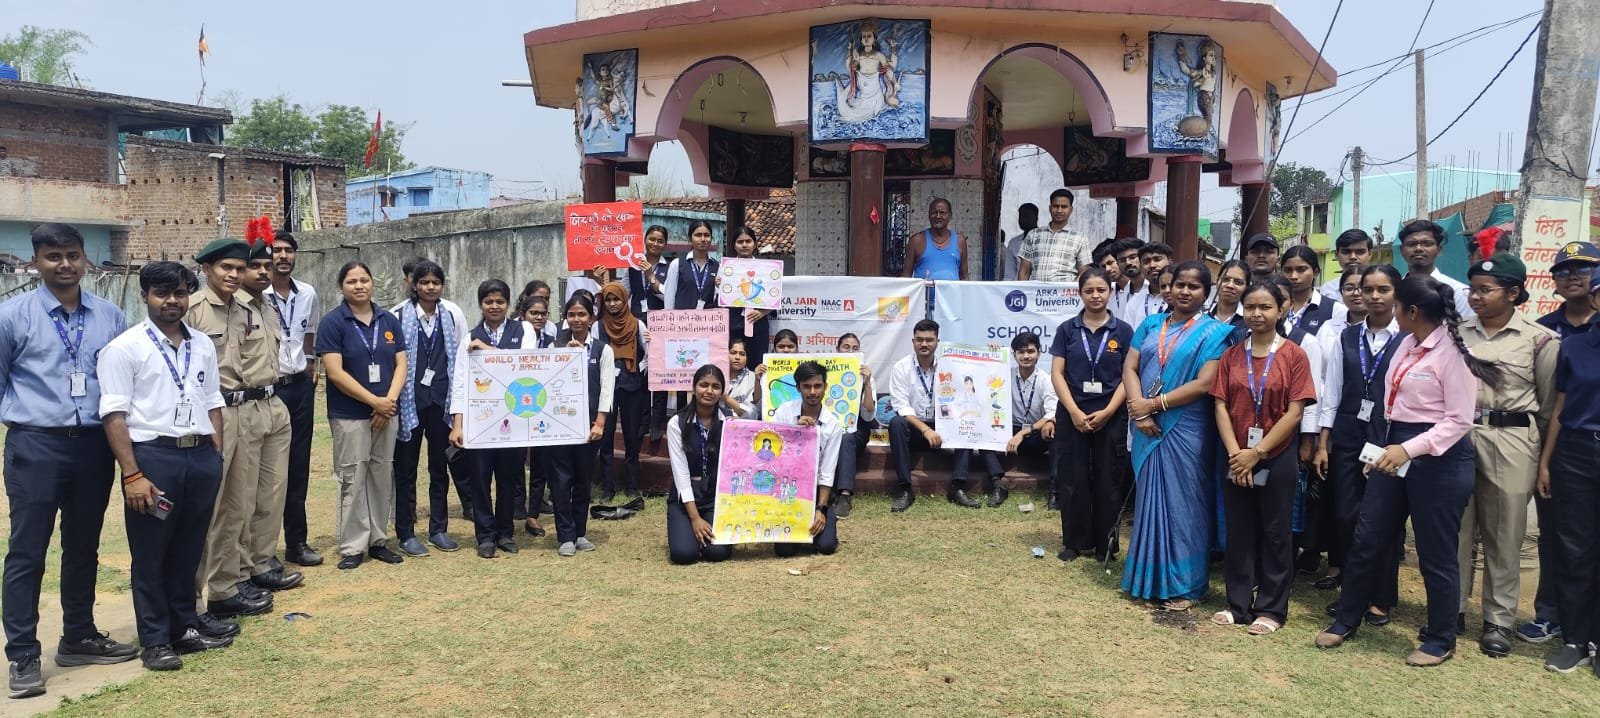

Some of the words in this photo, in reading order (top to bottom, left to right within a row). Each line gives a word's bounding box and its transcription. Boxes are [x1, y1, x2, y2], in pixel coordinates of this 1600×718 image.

[1535, 215, 1568, 238] सिंह
[780, 297, 792, 305] KA
[794, 297, 817, 305] JAIN
[845, 301, 854, 311] A
[1009, 296, 1025, 307] JGI
[1035, 297, 1080, 308] University
[779, 306, 817, 317] iversity
[987, 325, 1051, 339] SCHOOL
[806, 332, 840, 346] अभिया
[484, 355, 513, 364] WORLD
[518, 354, 551, 363] HEALTH
[554, 354, 571, 363] DAY
[511, 363, 516, 372] 7
[825, 363, 850, 372] EALTH
